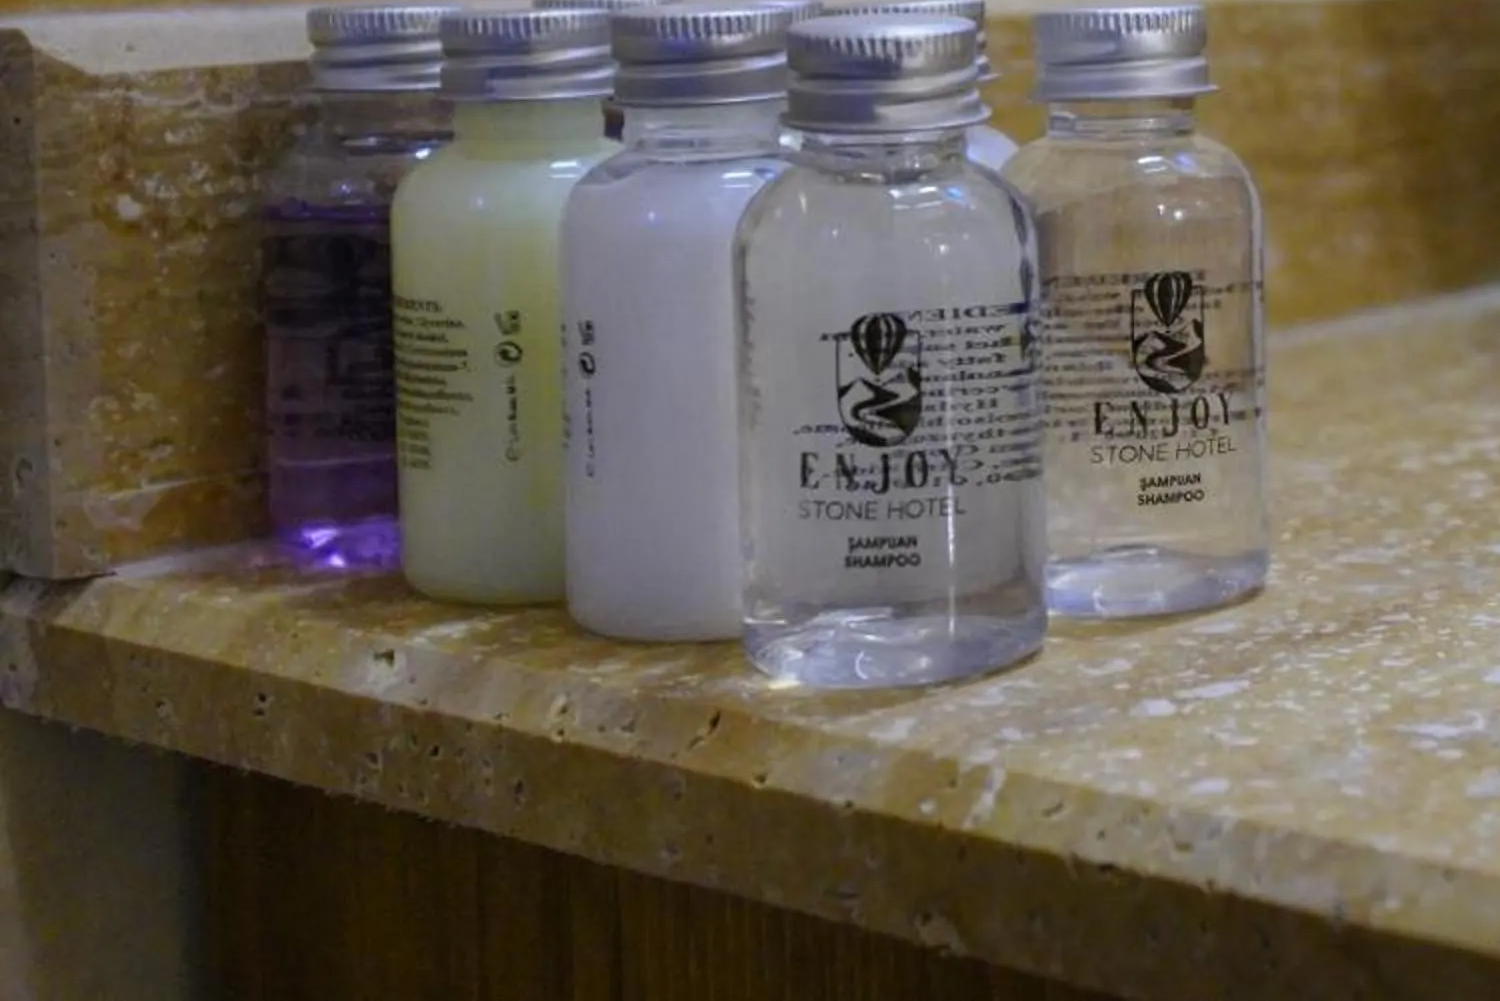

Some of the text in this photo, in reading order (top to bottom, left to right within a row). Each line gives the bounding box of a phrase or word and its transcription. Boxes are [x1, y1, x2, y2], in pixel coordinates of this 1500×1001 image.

[1093, 394, 1232, 437] ENJOY
[1090, 438, 1237, 464] STONE HOTEL
[800, 450, 959, 494] ENJOY
[799, 497, 967, 520] STONE HOTEL
[1138, 490, 1205, 506] SHAMPOO
[844, 553, 921, 569] SHAMPOO
